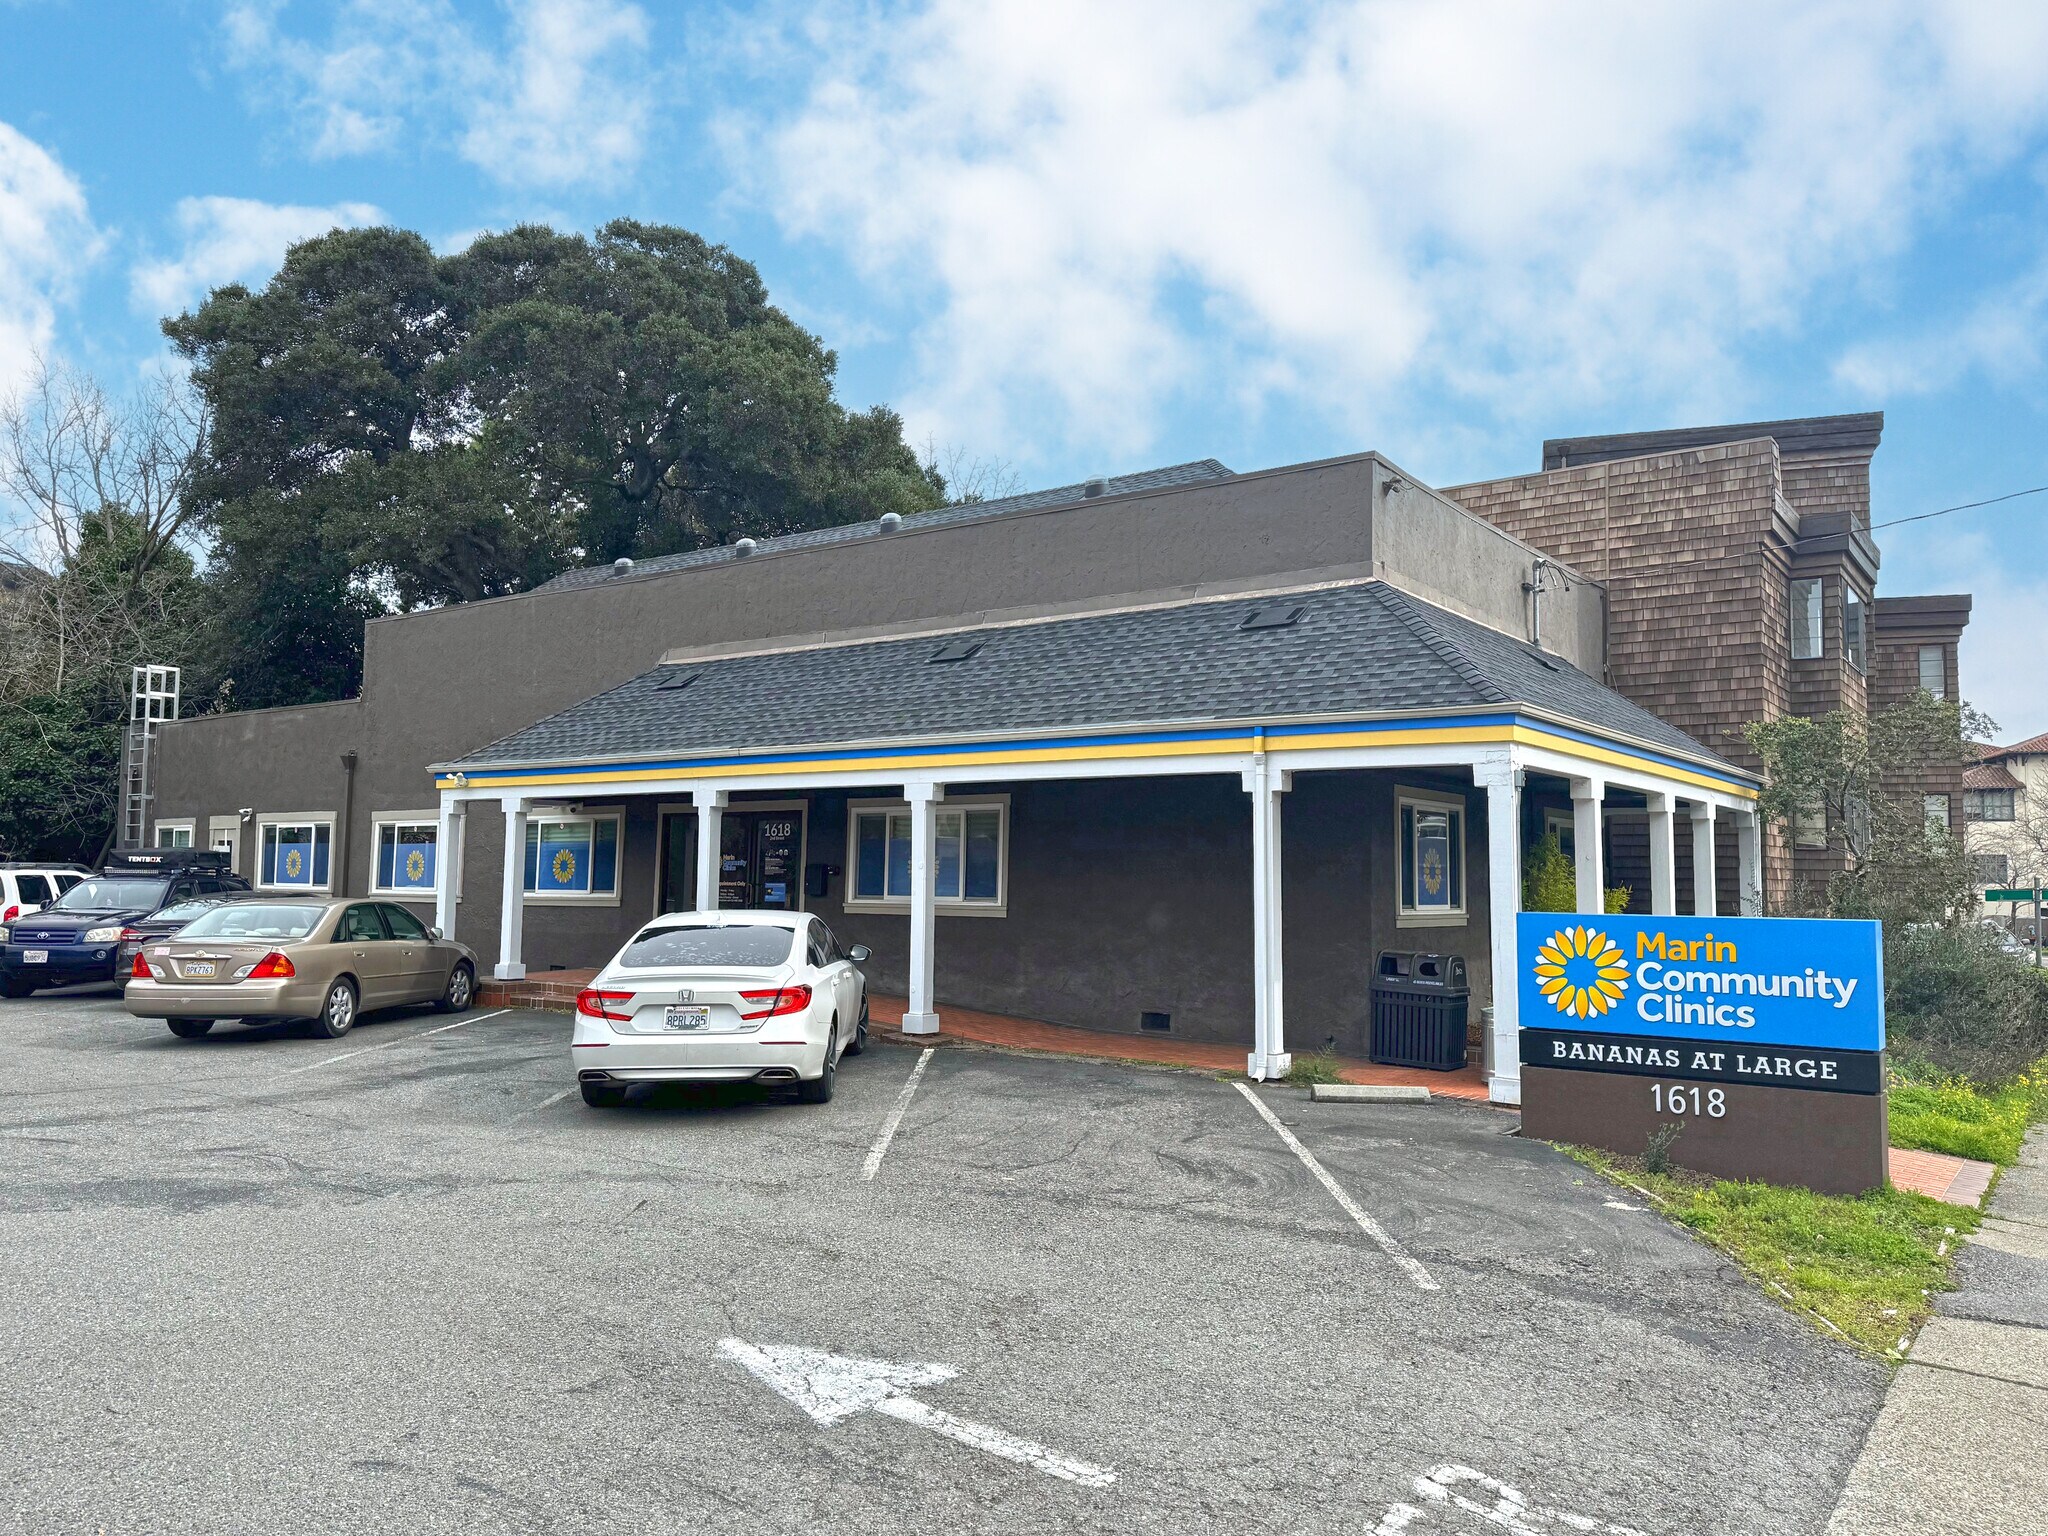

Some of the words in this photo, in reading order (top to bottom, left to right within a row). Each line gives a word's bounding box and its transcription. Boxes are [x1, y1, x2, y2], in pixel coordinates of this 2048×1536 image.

[764, 823, 791, 837] 1618
[1636, 931, 1738, 963] Marin
[1636, 961, 1859, 1010] Community
[667, 1015, 707, 1026] 8PRL285
[1637, 993, 1757, 1029] Clinics
[1553, 1041, 1681, 1067] BANANAS
[1691, 1052, 1726, 1072] AT
[1737, 1055, 1839, 1081] LARGE
[1651, 1083, 1727, 1119] 1618
